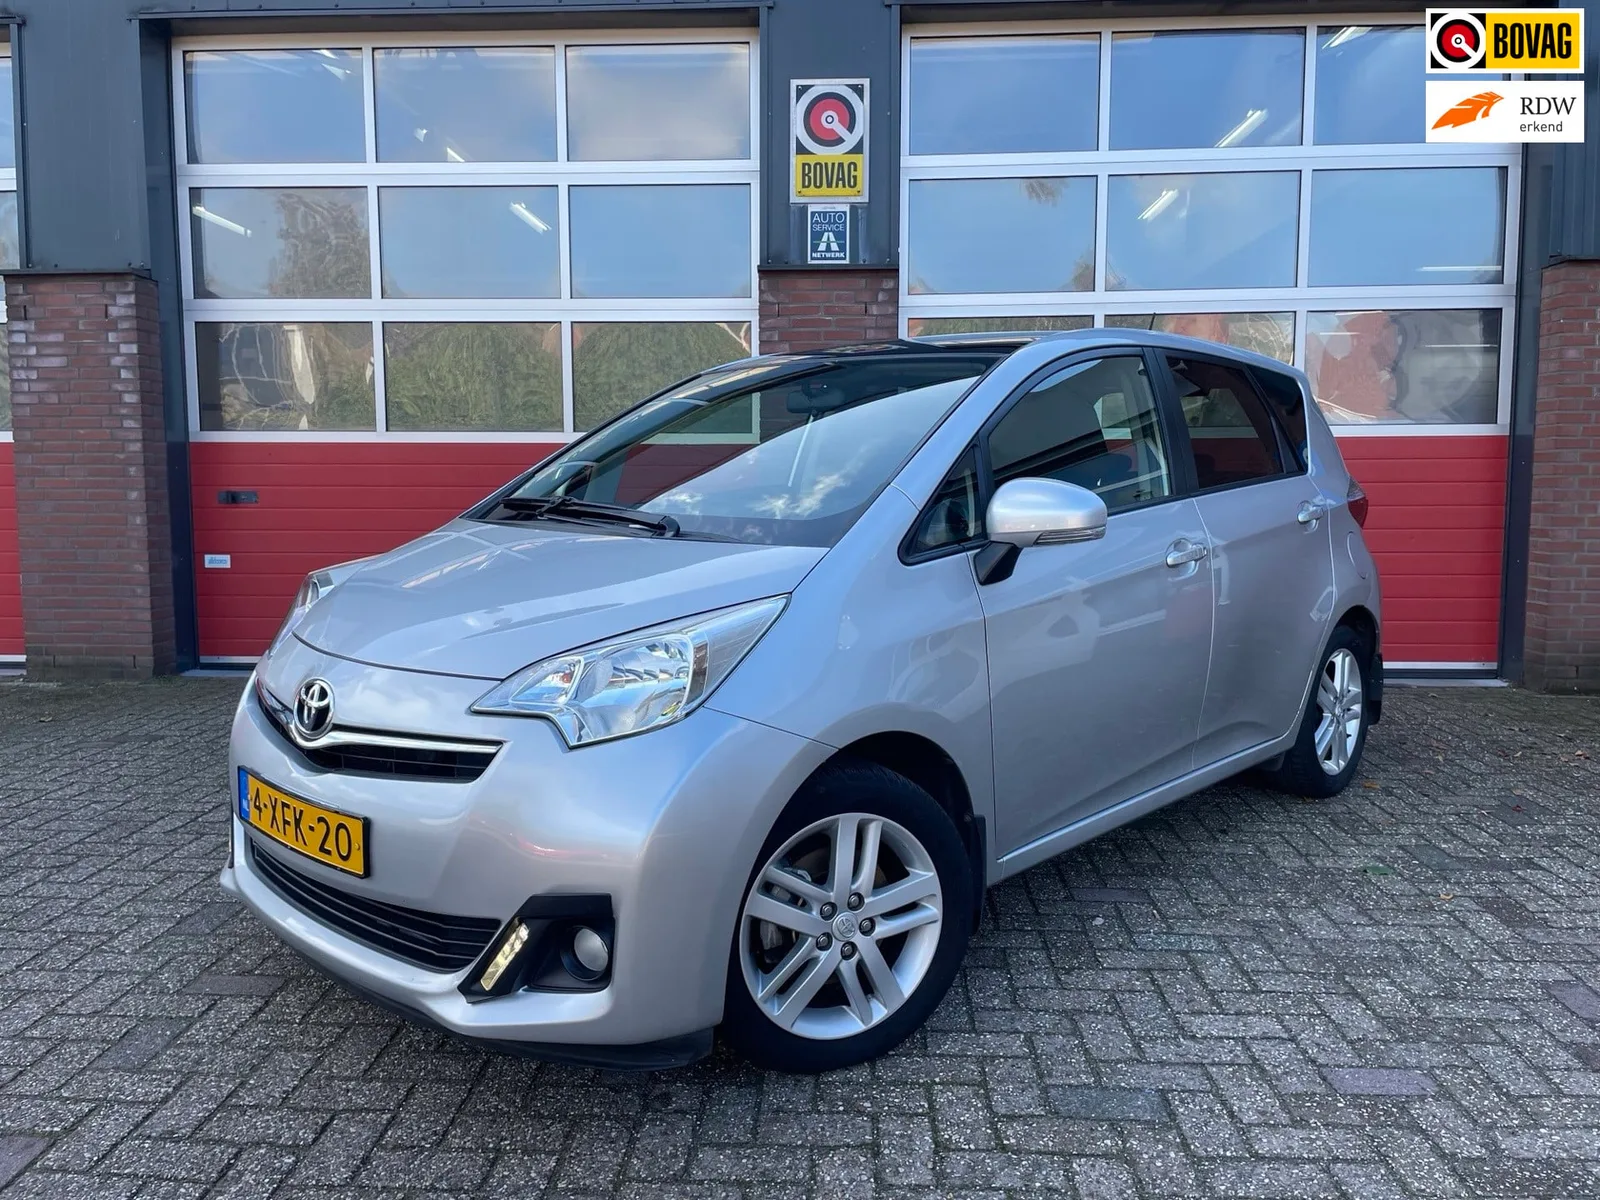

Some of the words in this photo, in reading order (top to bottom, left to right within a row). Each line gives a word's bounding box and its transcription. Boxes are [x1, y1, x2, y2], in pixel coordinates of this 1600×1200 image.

[801, 161, 858, 189] BOVAG
[812, 212, 845, 223] AUTO
[812, 223, 845, 231] SERVICE
[253, 787, 352, 862] 4-XFK-20
